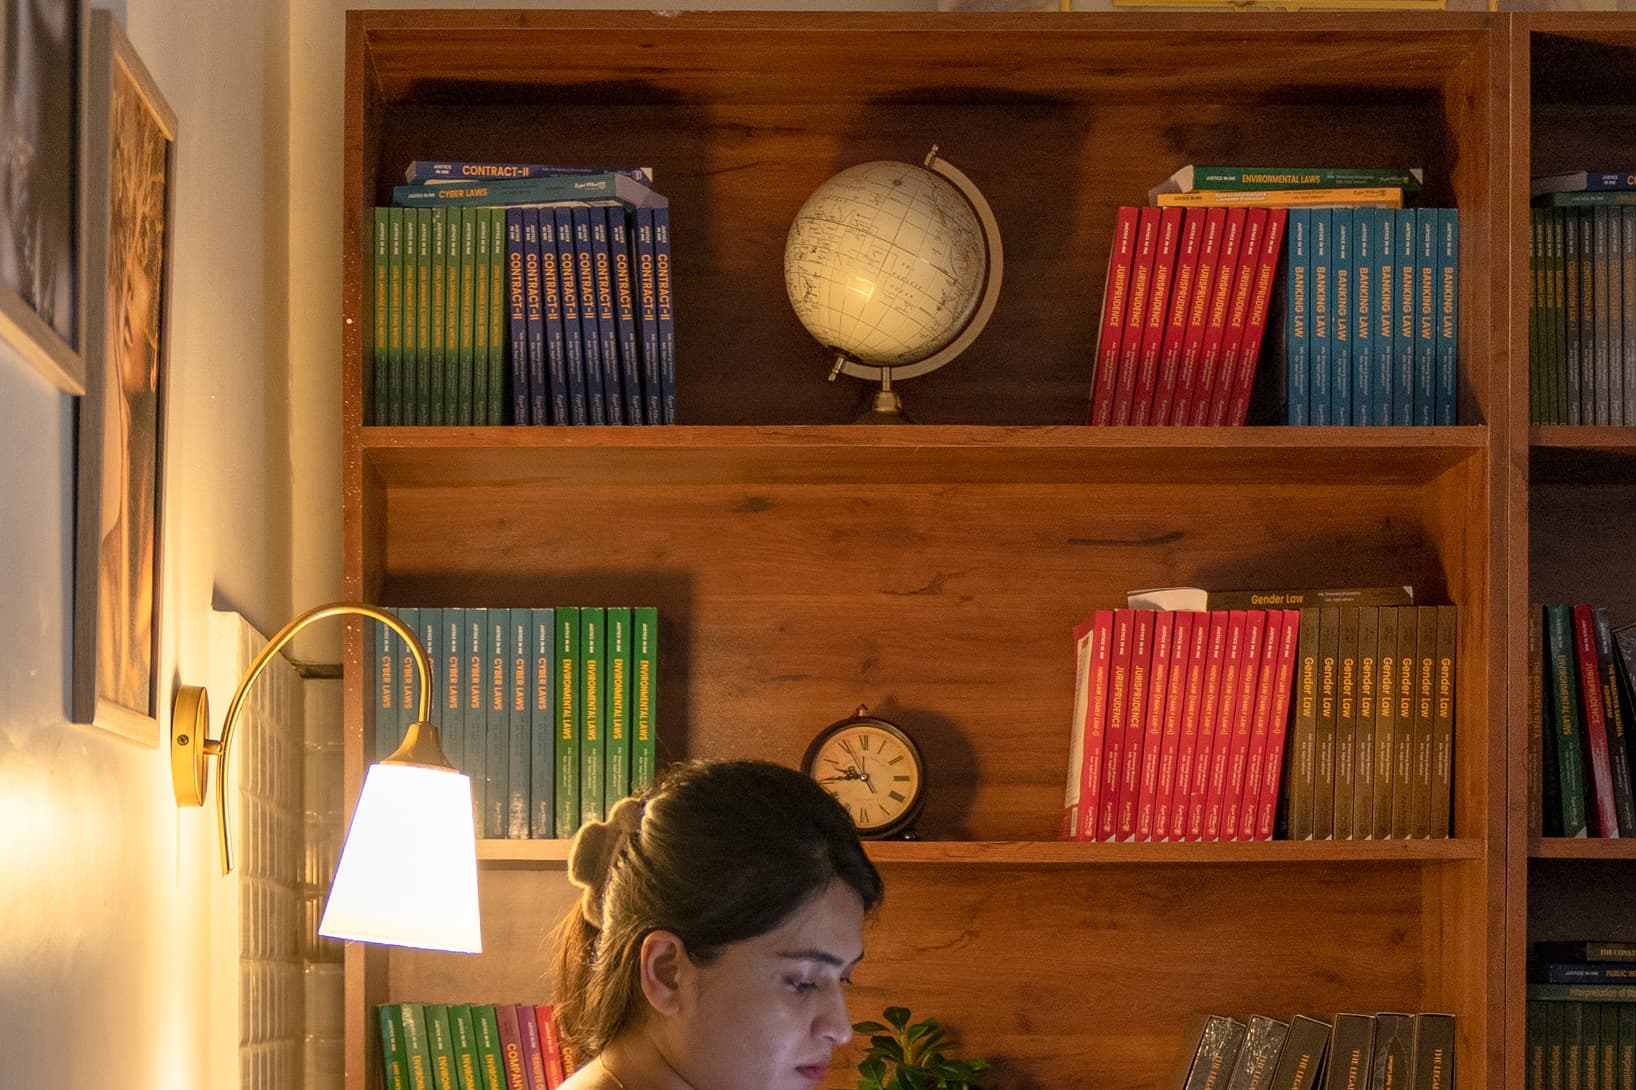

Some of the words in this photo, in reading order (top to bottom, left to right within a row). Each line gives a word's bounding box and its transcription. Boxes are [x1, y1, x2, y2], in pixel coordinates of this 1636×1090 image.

[462, 165, 529, 176] CONTRACT-II
[1242, 175, 1300, 183] ENVIRONMENTAL
[438, 189, 465, 198] CYBER
[466, 188, 488, 197] LAWS
[511, 253, 523, 320] CONTRACT-II
[527, 253, 539, 320] CONTRACT-II
[544, 253, 558, 320] CONTRACT-II
[562, 252, 576, 320] CONTRACT-II
[579, 252, 594, 319] CONTRACT-II
[596, 253, 613, 319] CONTRACT-II
[616, 254, 632, 320] CONTRACT-II
[641, 255, 654, 320] CONTRACT-II
[658, 254, 670, 320] CONTRACT-II
[1111, 264, 1126, 328] JURISPRUDENCE
[1131, 265, 1146, 328] JURISPRUDENCE
[1150, 265, 1167, 328] JURISPRUDENCE
[1173, 264, 1190, 327] JURISPRUDENCE
[1192, 264, 1210, 327] JURISPRUDENCE
[1212, 265, 1230, 328] JURISPRUDENCE
[1232, 265, 1250, 328] JURISPRUDENCE
[1252, 264, 1270, 326] JURISPRUDENCE
[1295, 266, 1304, 312] BANKING
[1317, 266, 1325, 312] BANKING
[1338, 269, 1347, 315] BANKING
[1360, 267, 1368, 313] BANKING
[1382, 266, 1391, 312] BANKING
[1403, 266, 1412, 312] BANKING
[1422, 268, 1432, 314] BANKING
[1444, 267, 1453, 313] BANKING
[1295, 316, 1304, 338] LAW
[1316, 315, 1325, 338] LAW
[1337, 319, 1346, 341] LAW
[1360, 316, 1368, 339] LAW
[1381, 315, 1390, 337] LAW
[1403, 315, 1412, 338] LAW
[1422, 317, 1431, 339] LAW
[1443, 316, 1452, 338] LAW
[1251, 594, 1284, 604] Gender
[1286, 594, 1304, 603] Law
[382, 656, 391, 683] CYBER
[404, 657, 412, 684] CYBER
[450, 656, 458, 684] CYBER
[471, 656, 480, 684] CYBER
[494, 658, 503, 685] CYBER
[516, 658, 524, 686] CYBER
[538, 657, 547, 685] CYBER
[1304, 657, 1314, 695] Gender
[1323, 657, 1334, 695] Gender
[1343, 658, 1353, 696] Gender
[1363, 658, 1373, 695] Gender
[1382, 657, 1392, 694] Gender
[1401, 658, 1412, 695] Gender
[1422, 658, 1432, 695] Gender
[1441, 658, 1450, 695] Gender
[404, 686, 412, 709] LAWS
[449, 685, 457, 709] LAWS
[471, 685, 480, 709] LAWS
[494, 687, 502, 711] LAWS
[516, 687, 524, 711] LAWS
[538, 686, 546, 710] LAWS
[562, 659, 571, 718] ENVIRONMENTAL
[587, 660, 596, 718] ENVIRONMENTAL
[613, 659, 624, 718] ENVIRONMENTAL
[640, 660, 648, 718] ENVIRONMENTAL
[1112, 666, 1125, 728] JURISPRUDENCE
[1131, 665, 1144, 728] JURISPRUDENCE
[1586, 662, 1600, 724] JURISPRUDENCE
[1304, 697, 1312, 717] Law
[1323, 697, 1332, 718] Law
[1343, 699, 1352, 718] Law
[1362, 697, 1371, 718] Law
[1382, 697, 1391, 717] Law
[1401, 698, 1410, 718] Law
[1421, 698, 1431, 718] Law
[1440, 698, 1449, 718] Law
[562, 720, 572, 740] LAWS
[587, 721, 596, 740] LAWS
[613, 719, 622, 739] LAWS
[639, 721, 648, 740] LAWS
[1211, 1054, 1222, 1069] THE
[1298, 1053, 1309, 1068] THE
[1350, 1048, 1360, 1063] THE
[1433, 1048, 1442, 1062] THE
[1346, 1066, 1358, 1090] LEGAL
[1431, 1065, 1441, 1090] LEGAL
